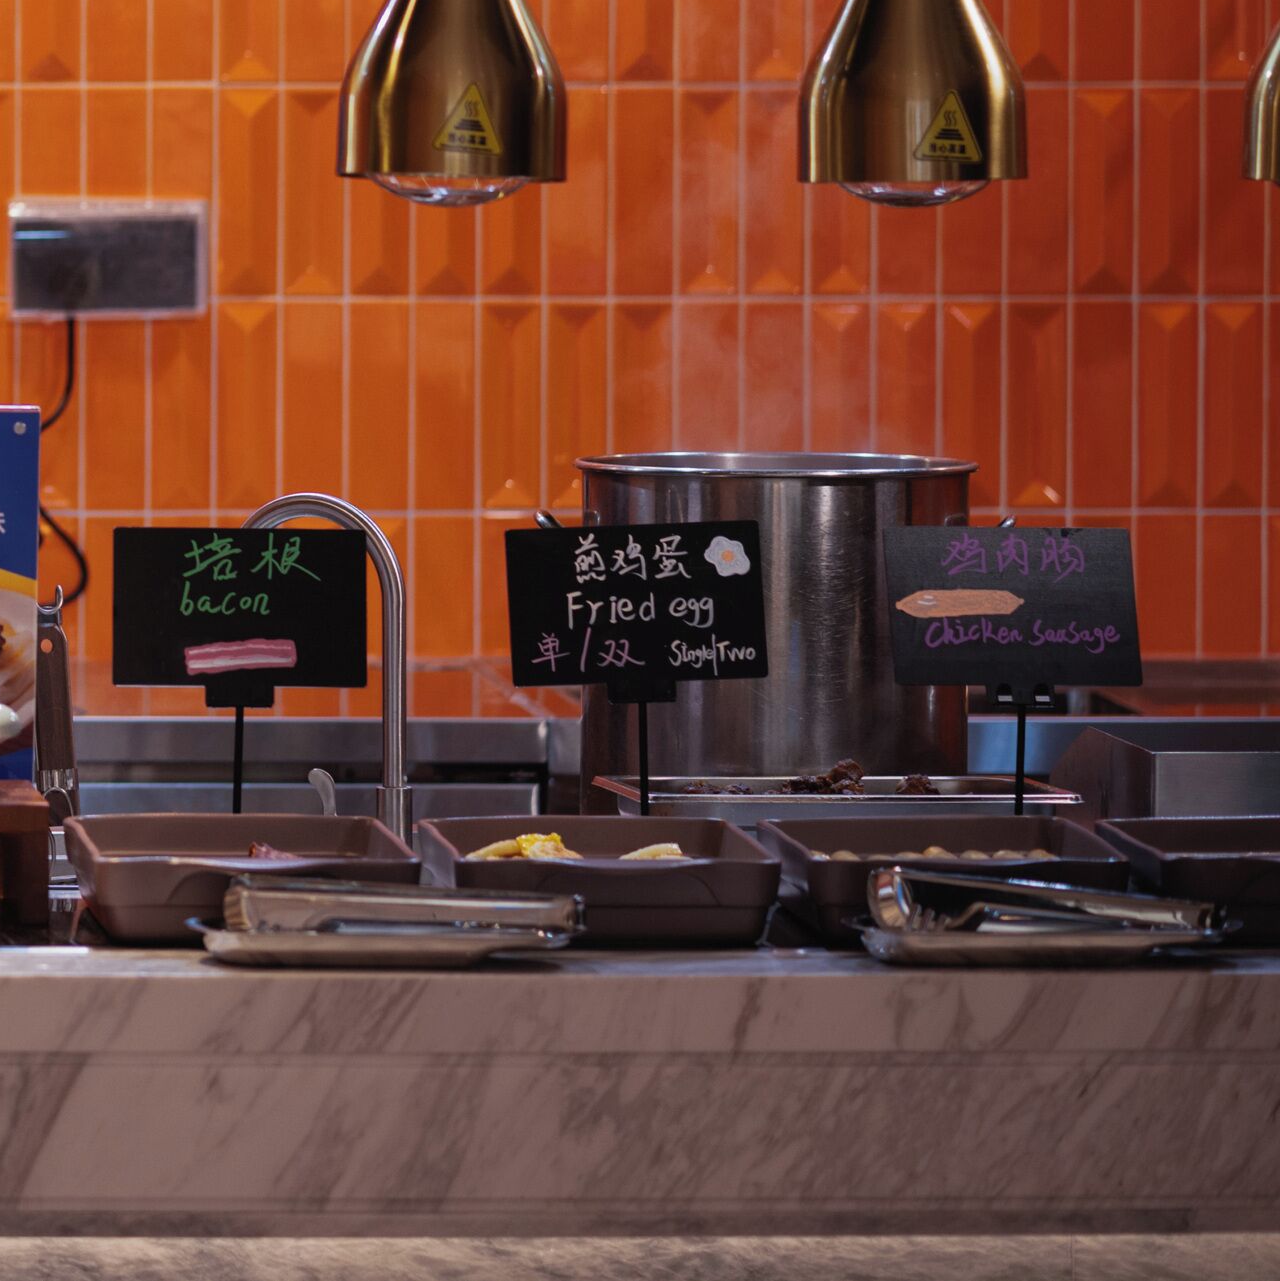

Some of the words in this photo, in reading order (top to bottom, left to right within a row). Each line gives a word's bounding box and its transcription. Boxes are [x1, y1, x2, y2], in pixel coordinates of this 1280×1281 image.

[182, 532, 321, 581] 培根
[573, 532, 692, 583] 煎鸡蛋
[941, 532, 1086, 583] 鸡肉肠
[180, 581, 270, 616] bacon
[566, 591, 655, 630] Fried
[669, 596, 714, 628] egg
[925, 617, 1022, 648] Chicken
